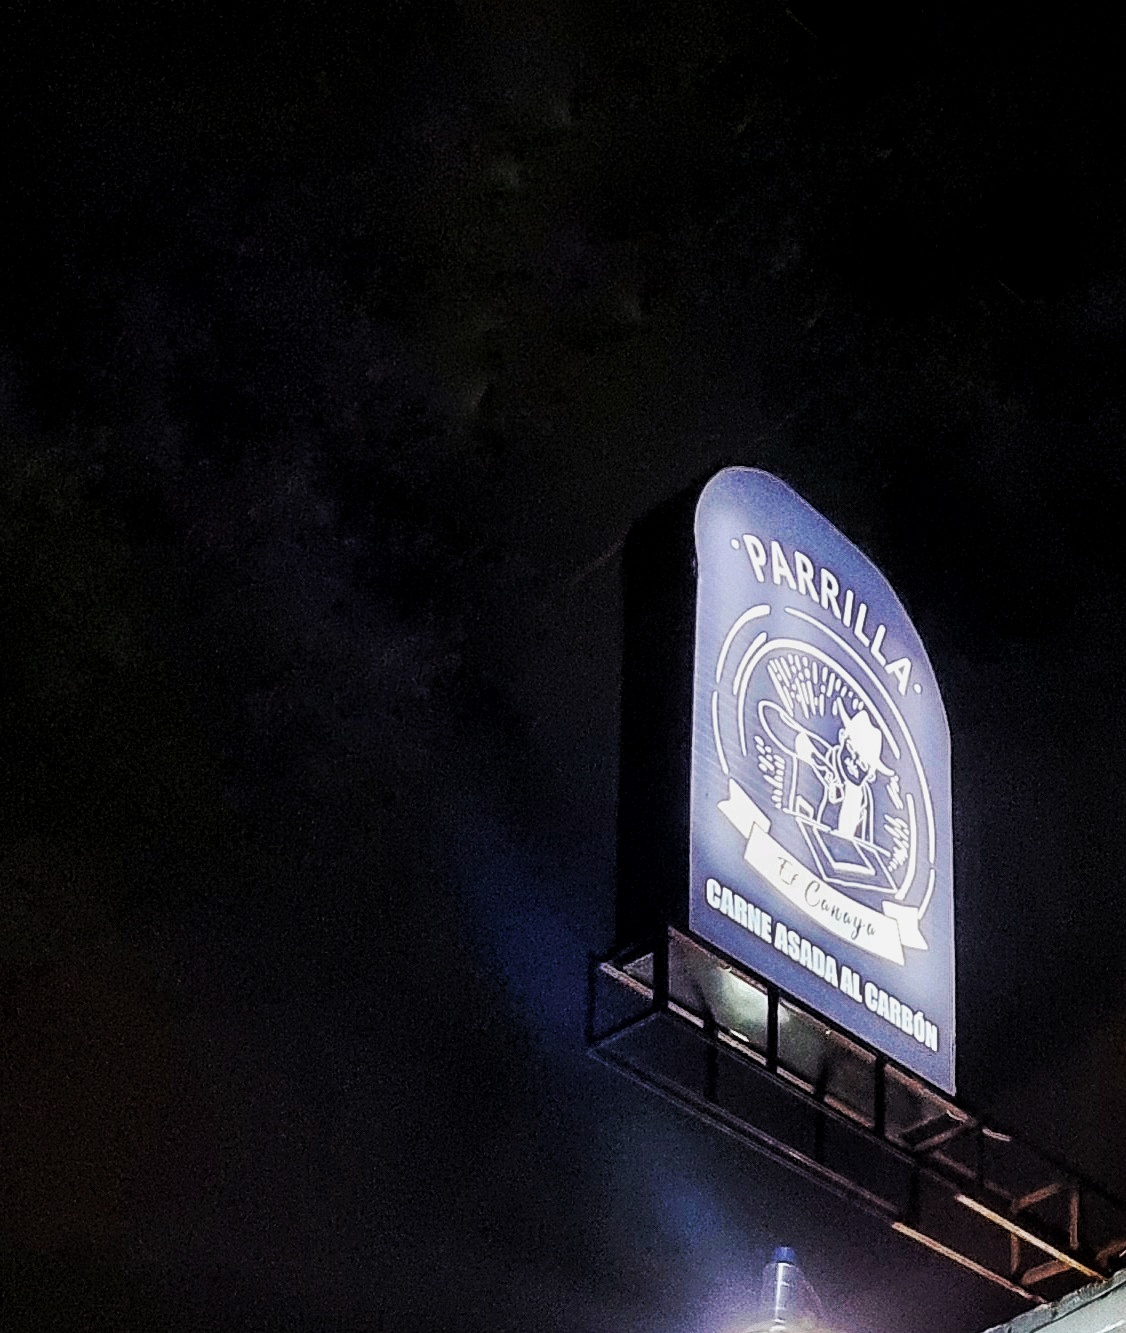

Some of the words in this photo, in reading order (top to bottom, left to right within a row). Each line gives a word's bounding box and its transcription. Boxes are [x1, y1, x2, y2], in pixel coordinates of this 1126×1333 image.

[742, 533, 912, 696] PARRILLA
[705, 877, 773, 944] CARNE
[774, 922, 839, 989] ASADA
[839, 965, 864, 1004] AL
[863, 980, 940, 1052] CARBÓN
